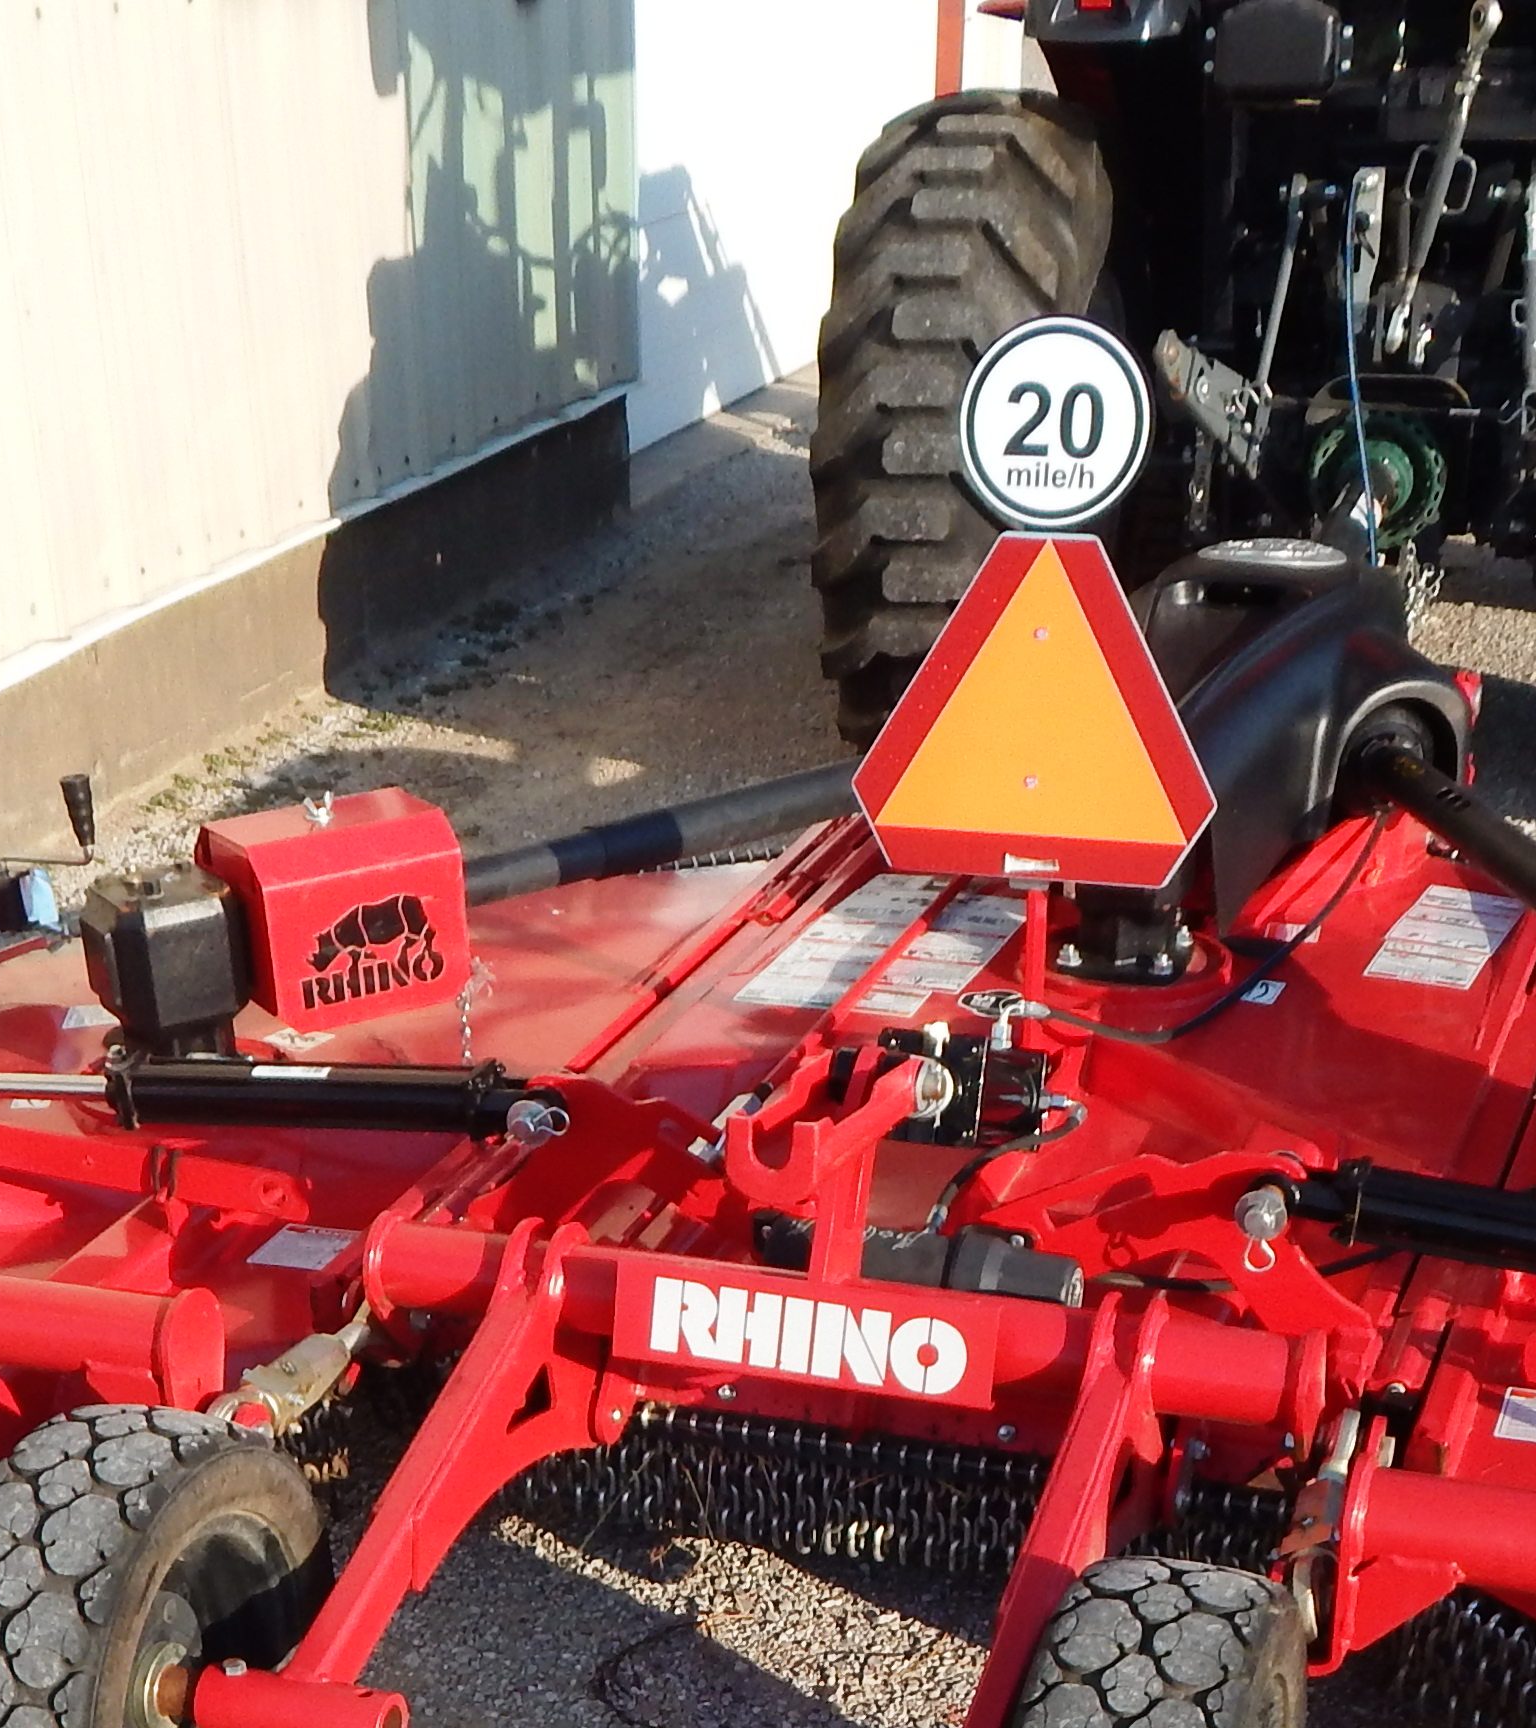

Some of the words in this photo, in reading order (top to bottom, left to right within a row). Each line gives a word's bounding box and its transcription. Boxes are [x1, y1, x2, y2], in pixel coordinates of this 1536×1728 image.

[1003, 380, 1105, 459] 20
[1006, 462, 1095, 490] mile/h
[301, 951, 445, 1009] RHINO
[649, 1276, 969, 1395] RHINO
